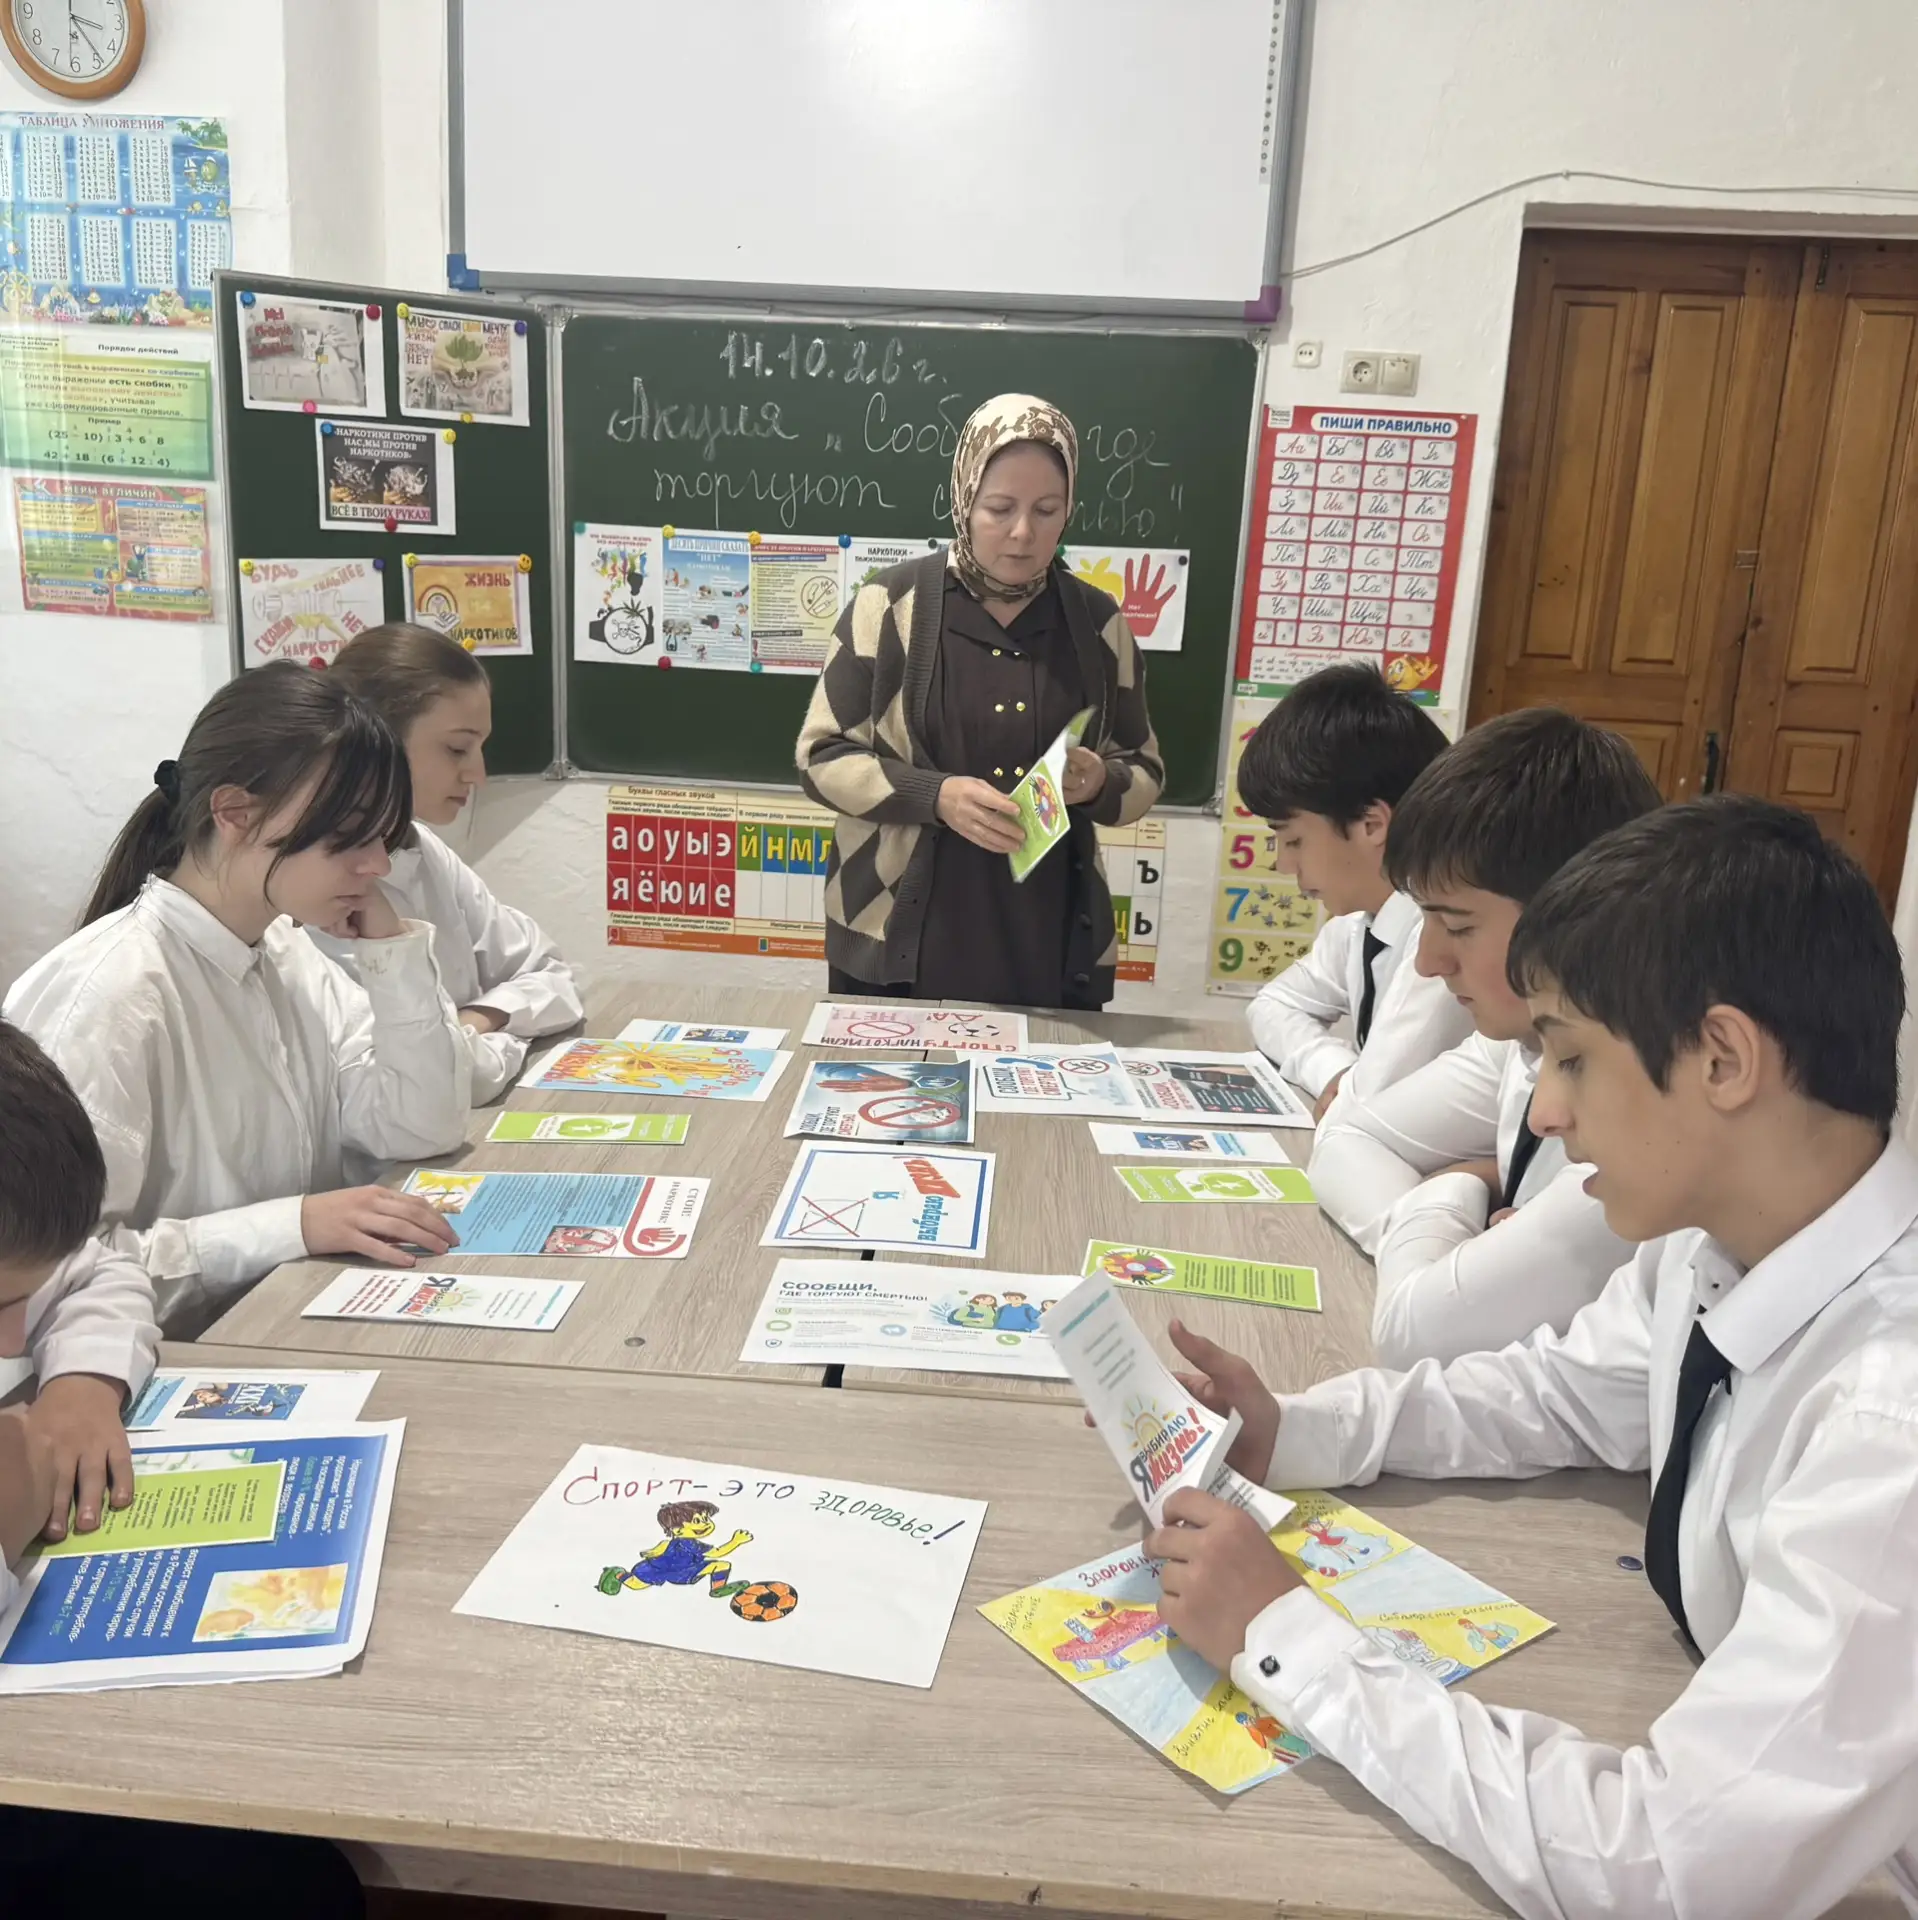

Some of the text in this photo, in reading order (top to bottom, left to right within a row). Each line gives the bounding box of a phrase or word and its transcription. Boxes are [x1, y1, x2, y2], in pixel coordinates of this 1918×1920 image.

[23, 3, 34, 19] 9
[114, 15, 124, 31] 3
[32, 29, 42, 45] 8
[107, 40, 116, 54] 4
[52, 48, 62, 65] 7
[92, 53, 101, 69] 5
[70, 57, 81, 73] 6
[20, 116, 165, 130] ТАБЛИЦА УМНОЖЕНИЯ
[98, 344, 179, 354] Порядок действий
[134, 379, 174, 389] скобки,
[88, 417, 122, 425] Пример
[1319, 416, 1452, 434] ПИШИ ПРАВИЛЬНО
[393, 433, 427, 442] ПРОТИВ
[607, 377, 1171, 501] Акция где
[382, 442, 417, 450] ПРОТИВ
[1280, 435, 1306, 454] Аа
[1325, 436, 1352, 456] Бб
[1375, 440, 1394, 459] Вв
[1278, 462, 1450, 489] Дд Жж
[102, 487, 156, 498] ВЕЛИЧИН
[653, 468, 898, 529] торгуют
[332, 504, 350, 516] ВСЁ
[352, 506, 358, 516] В
[360, 507, 393, 518] ТВОИХ
[1411, 524, 1430, 543] Оо
[867, 547, 908, 555] НАРКОТИКИ
[464, 572, 511, 587] ЖИЗНЬ
[1353, 574, 1382, 594] Хх
[628, 786, 715, 800] Буквы гласных звуков
[612, 825, 813, 862] а о у ы э й н м
[1229, 834, 1255, 870] 5
[612, 870, 732, 908] я ё ю и е
[1224, 887, 1250, 923] 7
[1218, 938, 1244, 972] 9
[927, 1012, 984, 1022] ДА!
[820, 1036, 920, 1048] НАРКОТИКАМ
[923, 1039, 1018, 1052] СПОРТУ
[865, 1292, 928, 1301] СМЕРТЬЮ!
[1131, 1415, 1187, 1503] Я ВЫБИРАЮ
[141, 1562, 180, 1638] России составляет
